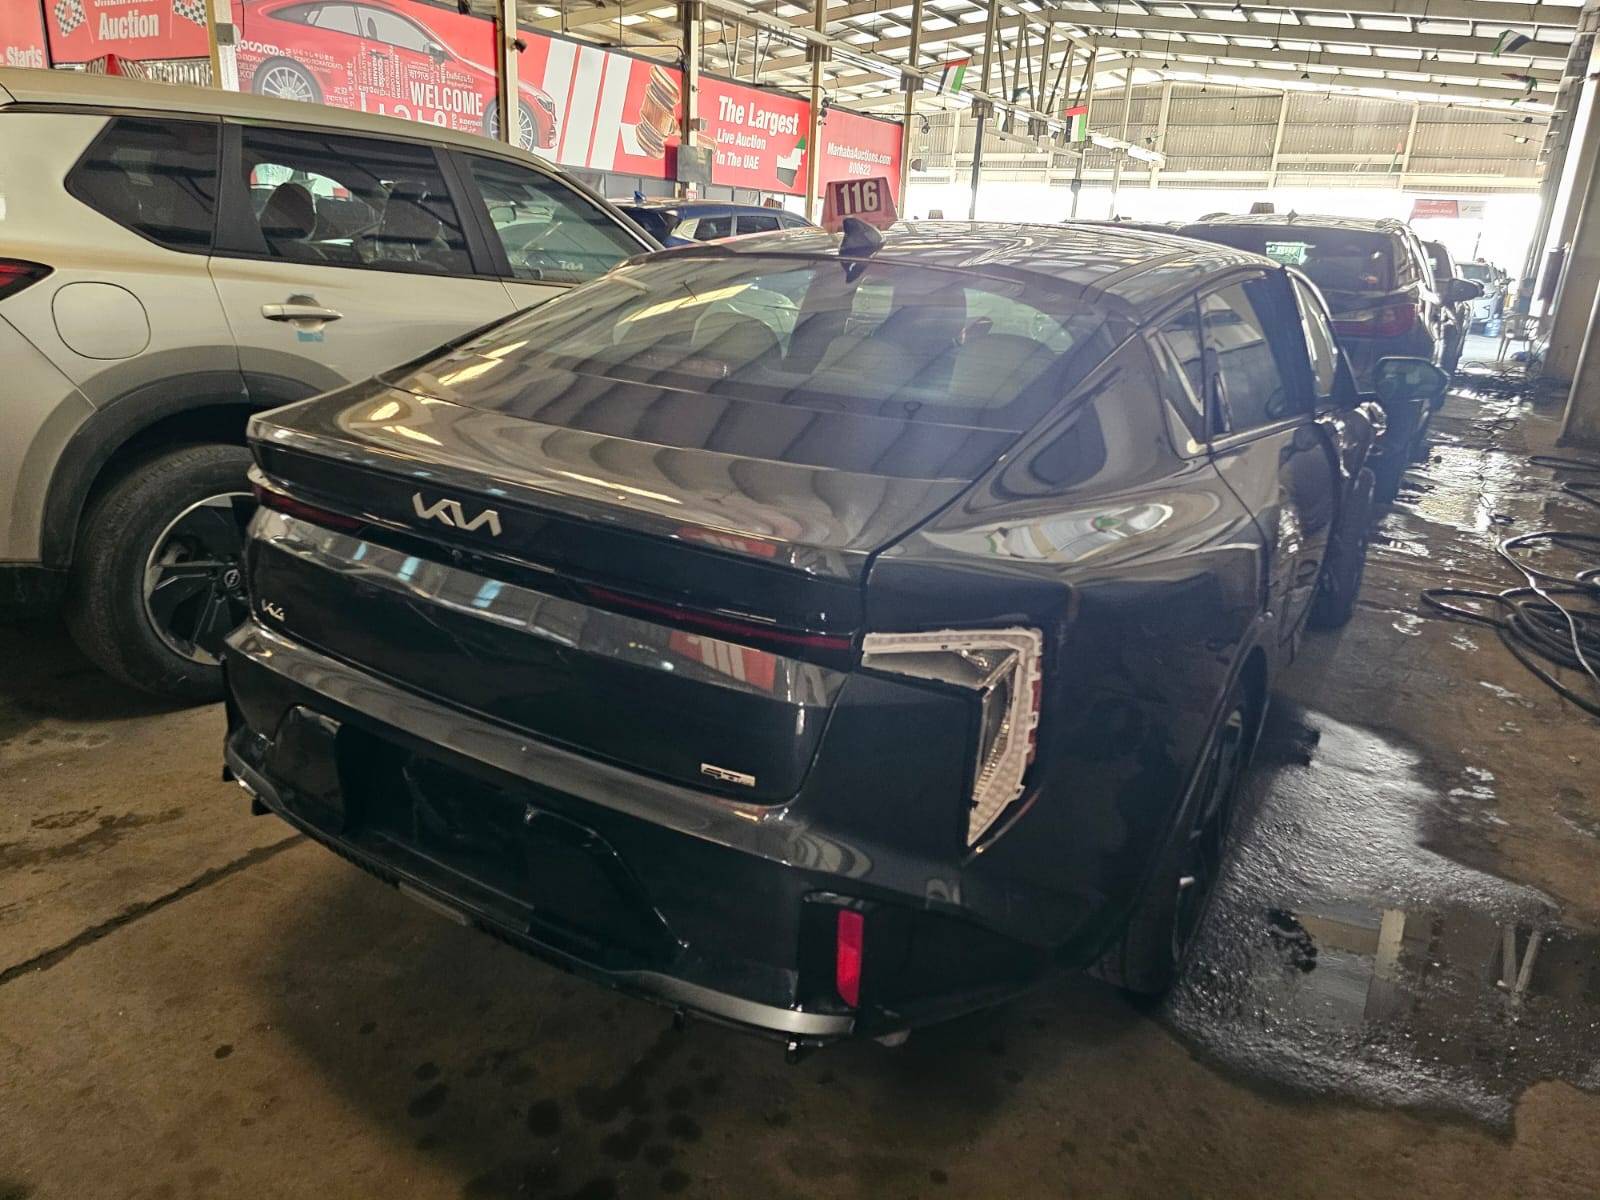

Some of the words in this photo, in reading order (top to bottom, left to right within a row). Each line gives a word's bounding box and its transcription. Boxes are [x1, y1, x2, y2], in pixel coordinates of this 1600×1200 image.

[98, 10, 160, 41] Auction
[7, 44, 43, 68] Starts
[410, 81, 483, 116] WELCOME
[719, 95, 745, 125] The
[748, 102, 799, 136] Largest
[717, 128, 735, 144] Live
[735, 132, 767, 150] Auction
[716, 150, 725, 165] In
[727, 151, 742, 167] The
[743, 154, 760, 170] UAE
[827, 142, 892, 165] MarhabaAuctions.com
[840, 181, 878, 214] 116
[412, 492, 502, 537] KIA
[261, 599, 286, 622] K4
